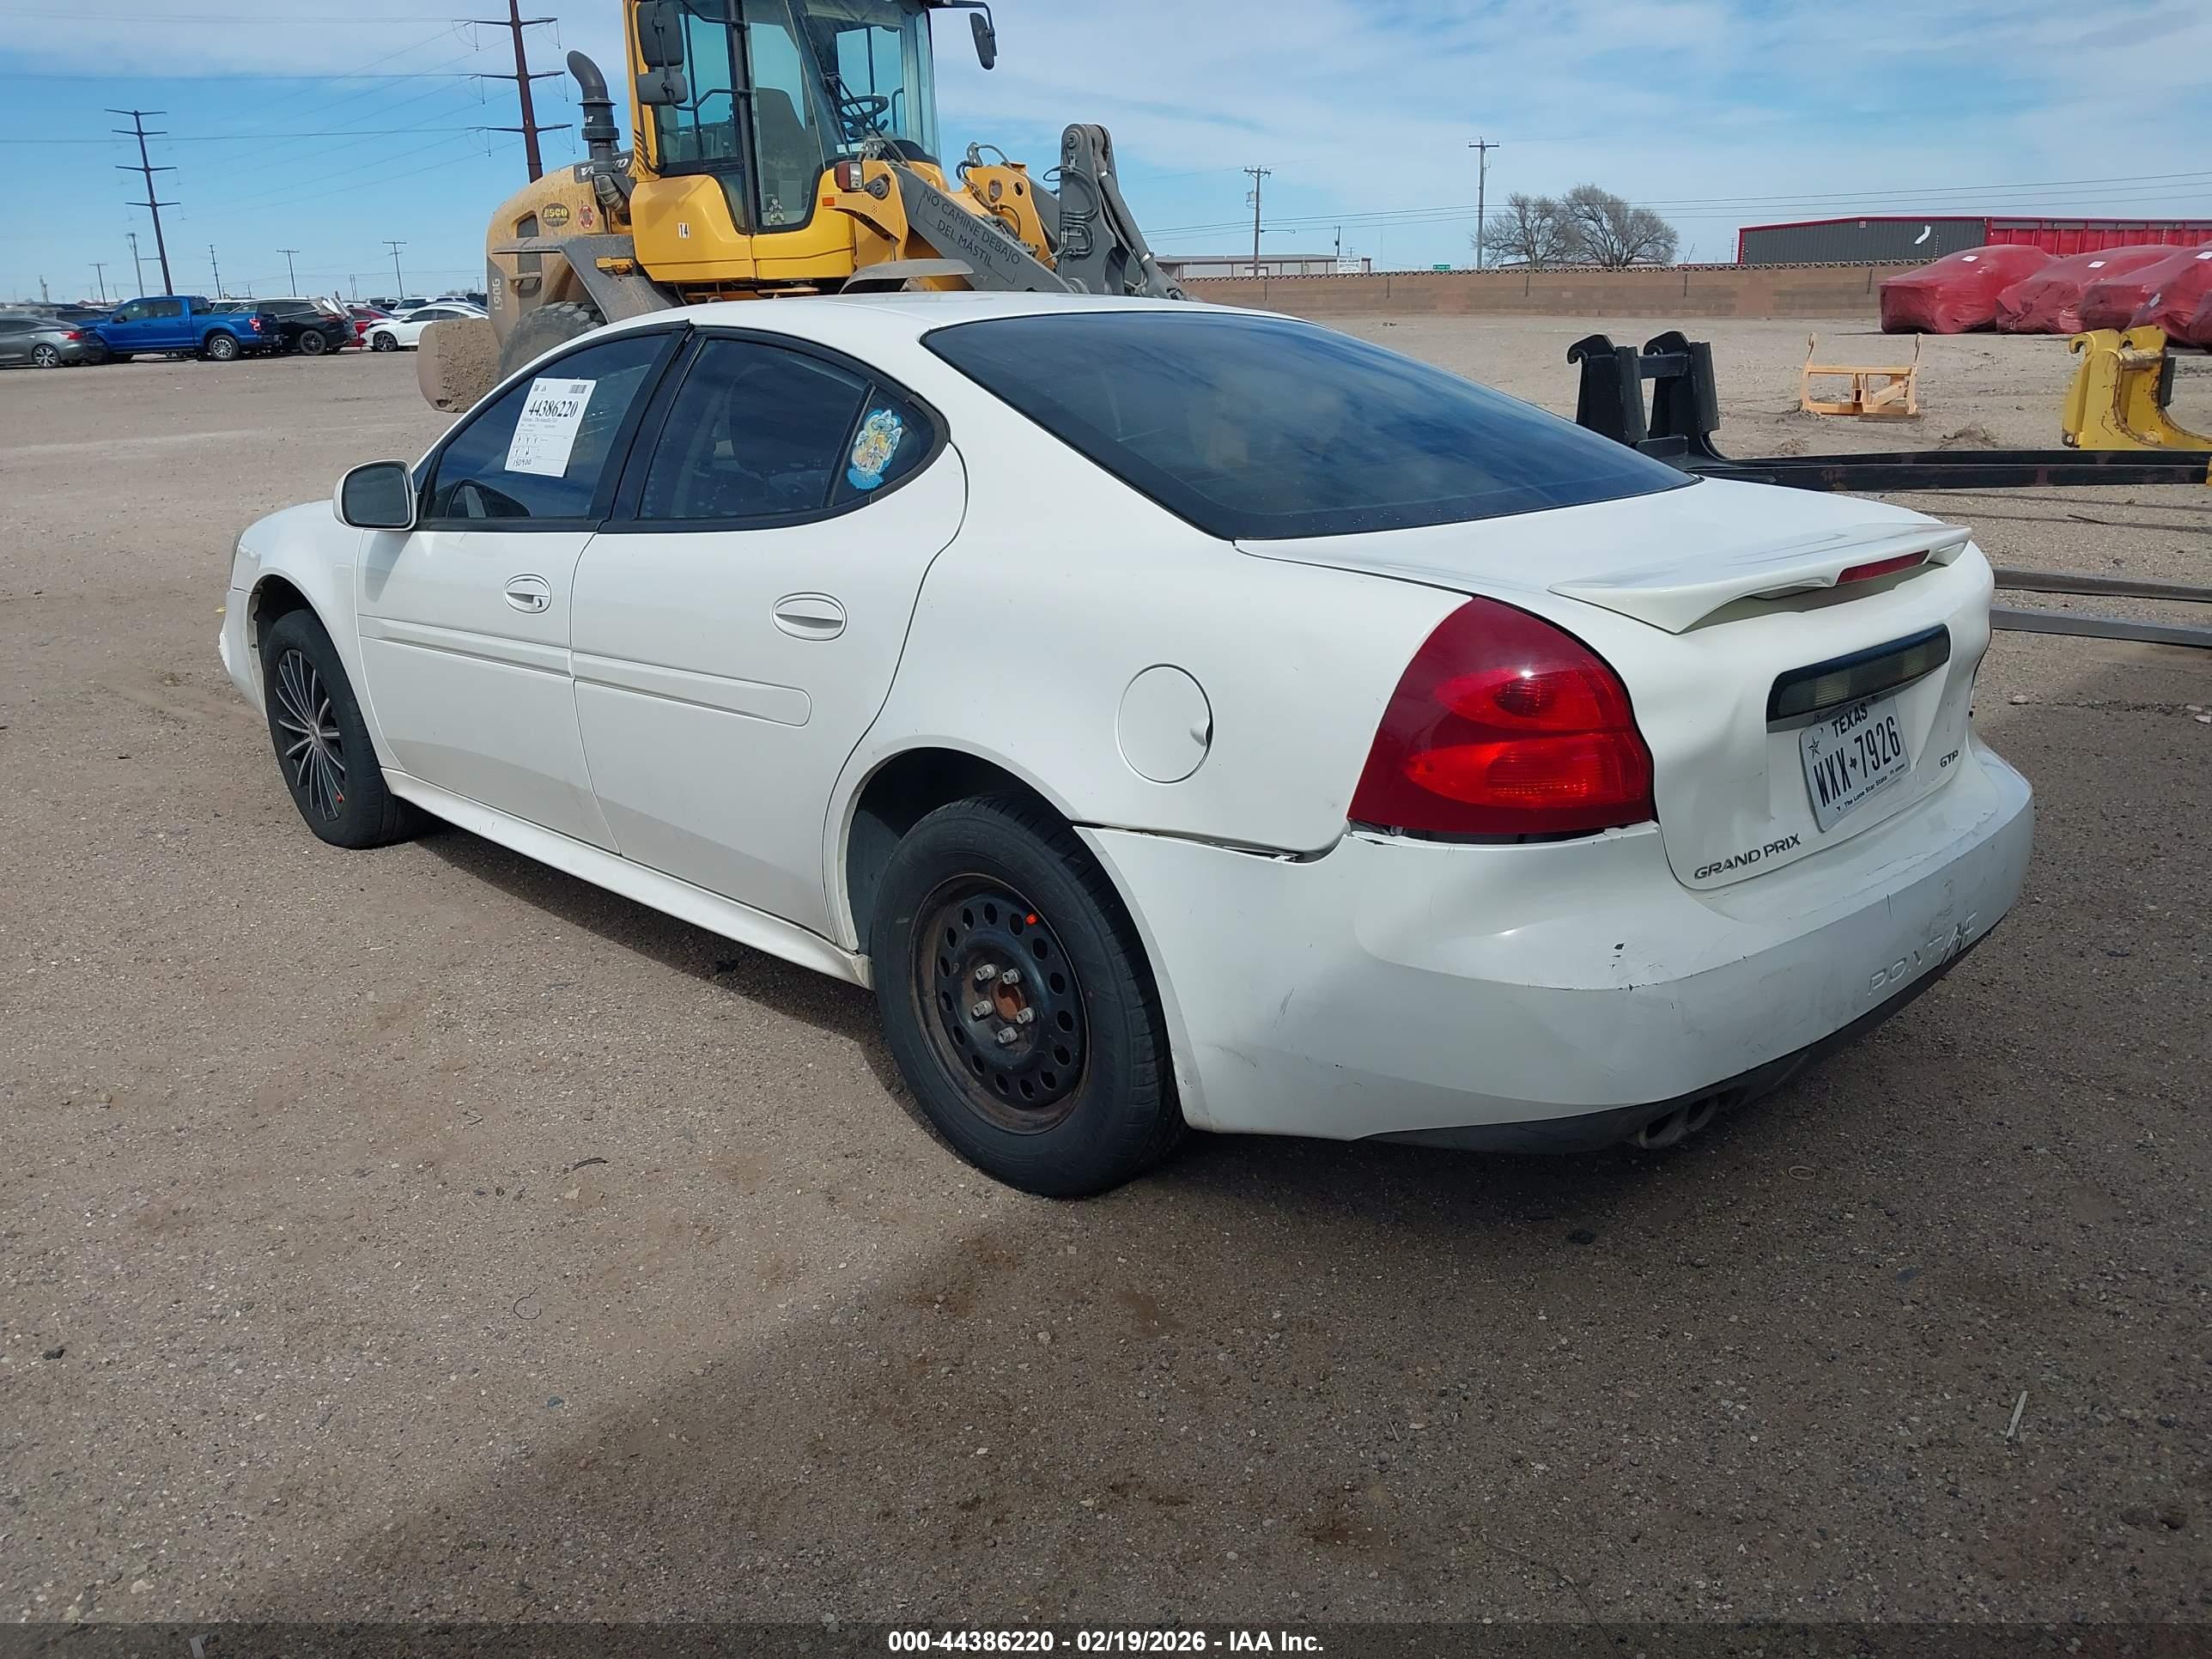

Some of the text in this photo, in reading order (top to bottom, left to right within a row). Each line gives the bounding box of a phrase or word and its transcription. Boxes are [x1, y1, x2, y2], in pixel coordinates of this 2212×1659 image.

[679, 223, 689, 238] 14
[922, 190, 1020, 264] NO CAMINE DEBAJO
[937, 219, 994, 268] DEL MÁSTIL
[528, 399, 579, 418] 44386220
[1832, 702, 1869, 738] TEXAS
[1854, 715, 1901, 779] 7926
[1940, 750, 1959, 768] GTP
[1844, 775, 1888, 808] The Lone Star State
[1694, 833, 1802, 879] GRAND PRIX
